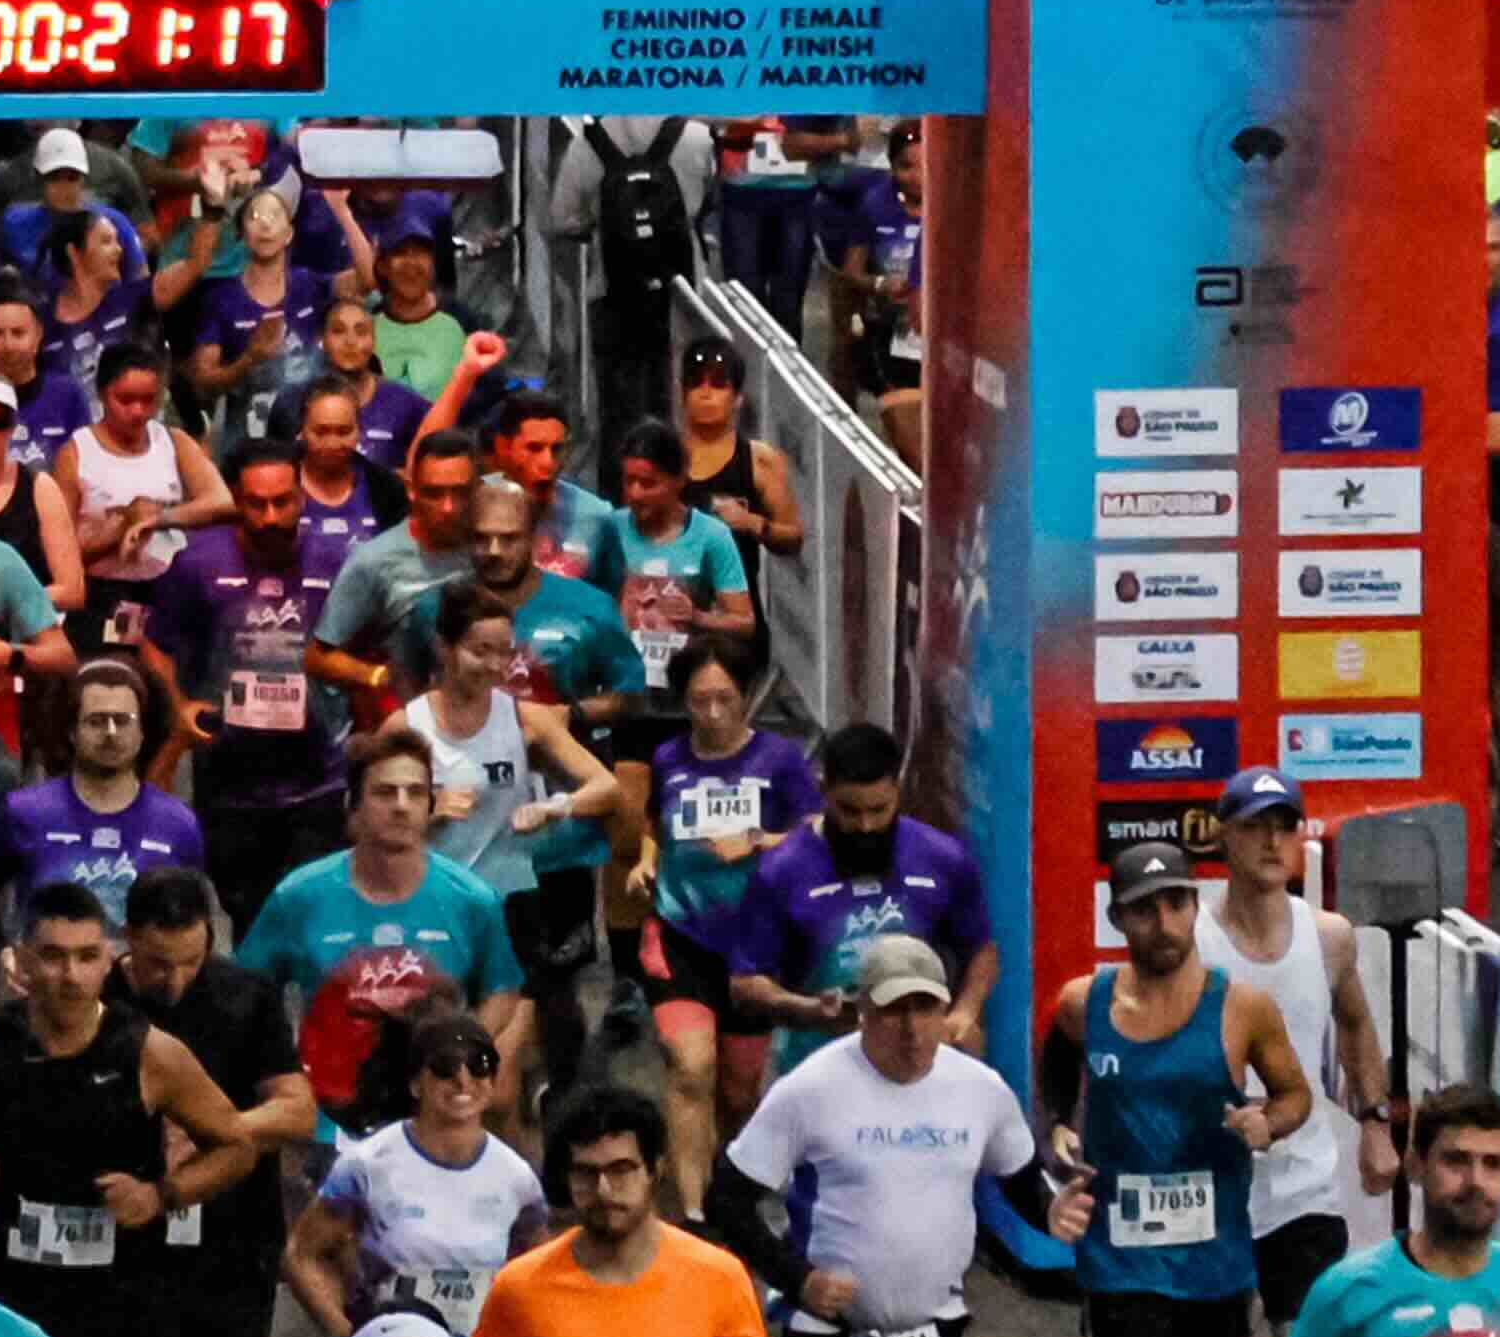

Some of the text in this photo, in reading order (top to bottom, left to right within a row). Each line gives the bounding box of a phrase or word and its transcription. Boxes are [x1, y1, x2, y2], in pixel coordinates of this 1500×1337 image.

[602, 7, 746, 31] FEMININO
[779, 6, 884, 30] FEMALE
[610, 36, 747, 58] CHEGADA
[782, 36, 875, 57] FINISH
[559, 65, 726, 89] MARATONA
[759, 63, 925, 87] MARATHON
[1148, 1188, 1208, 1211] 17059
